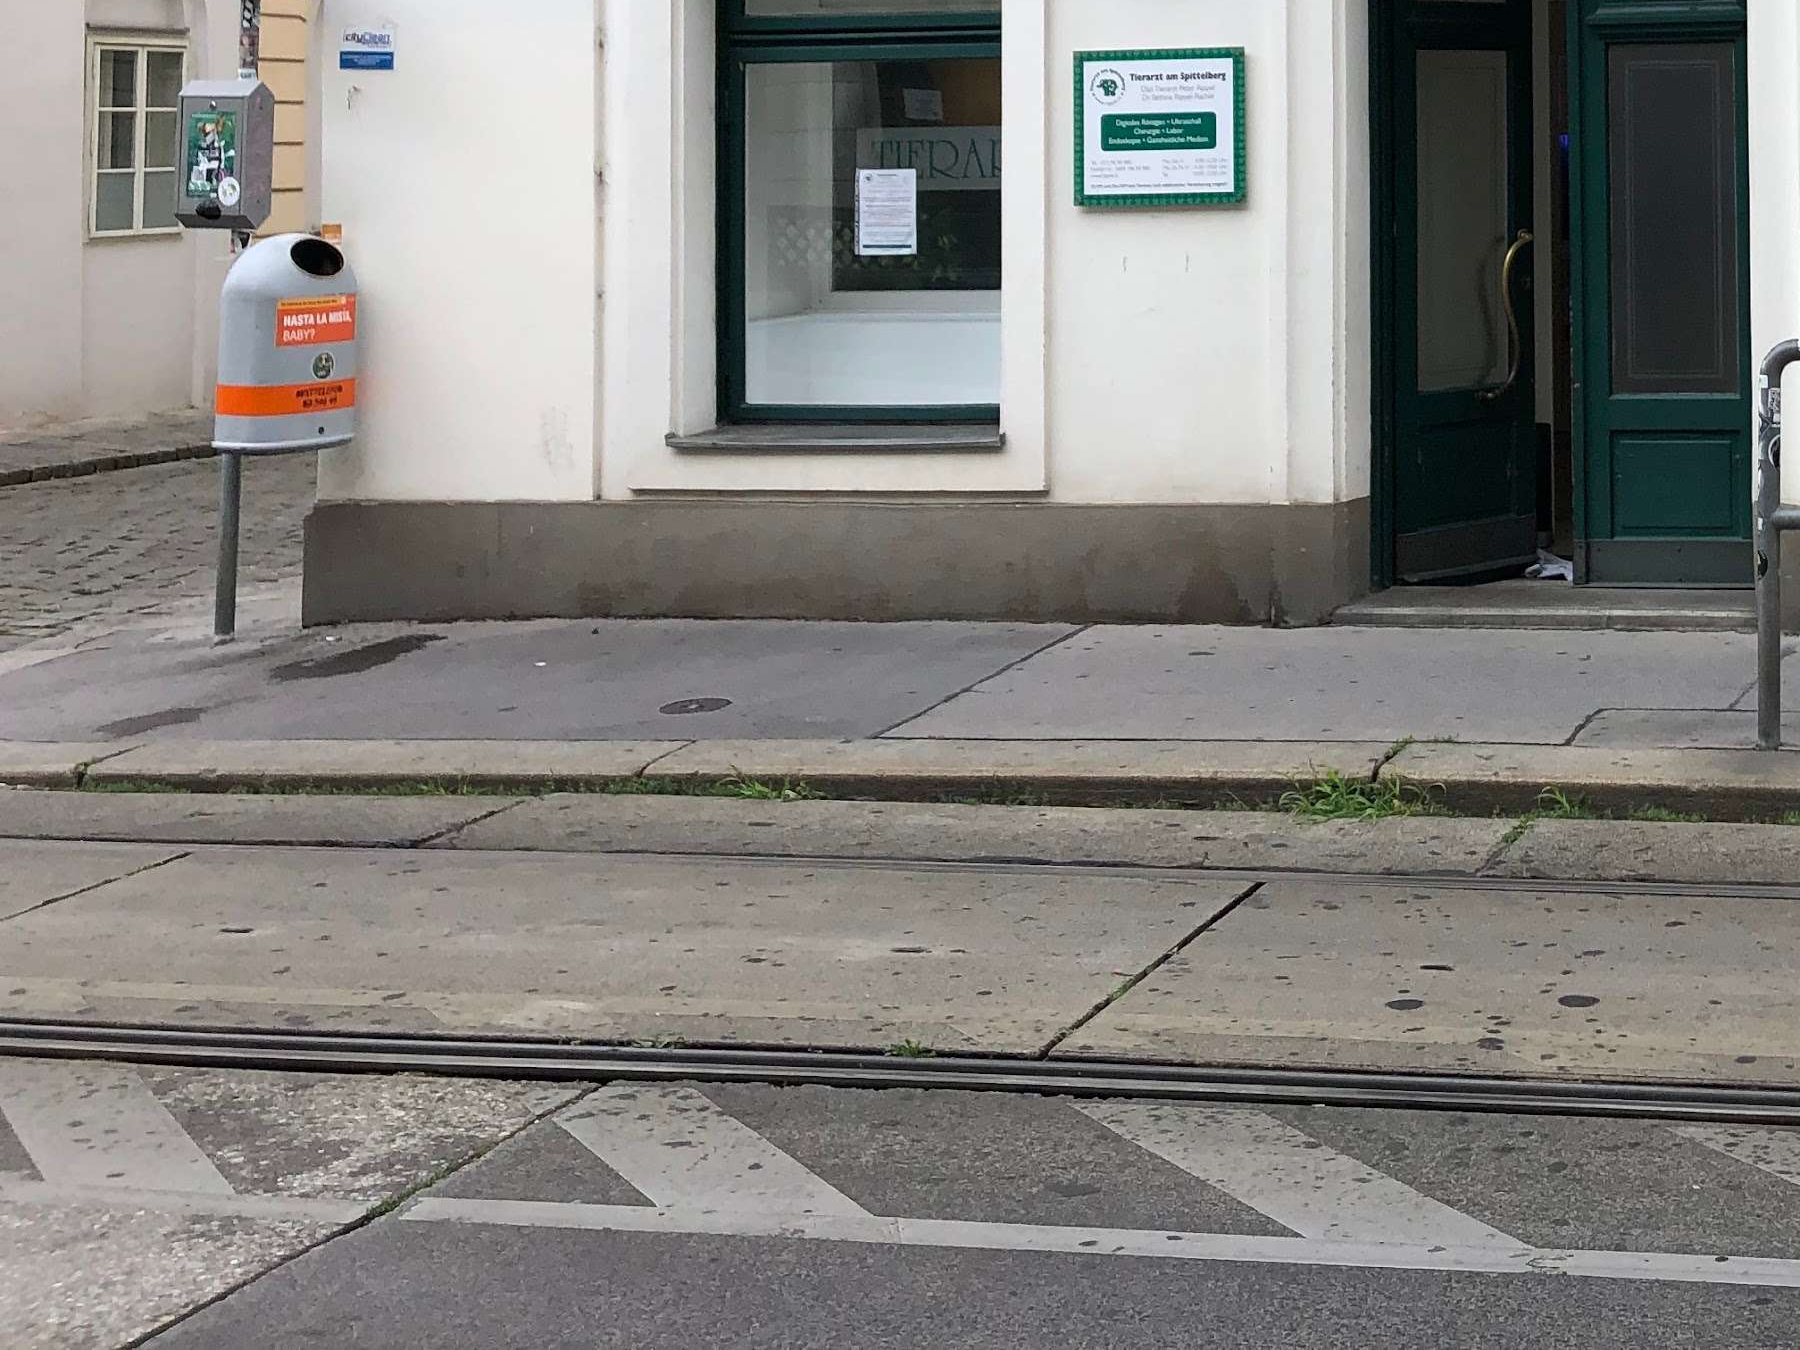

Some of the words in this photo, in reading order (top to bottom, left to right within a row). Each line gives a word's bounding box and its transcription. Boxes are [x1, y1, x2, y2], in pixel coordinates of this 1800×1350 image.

[1129, 73, 1163, 81] Tierarzt
[1180, 71, 1227, 82] Spittelberg
[283, 313, 315, 327] HASTA
[316, 312, 328, 324] LA
[283, 328, 316, 342] BABY?
